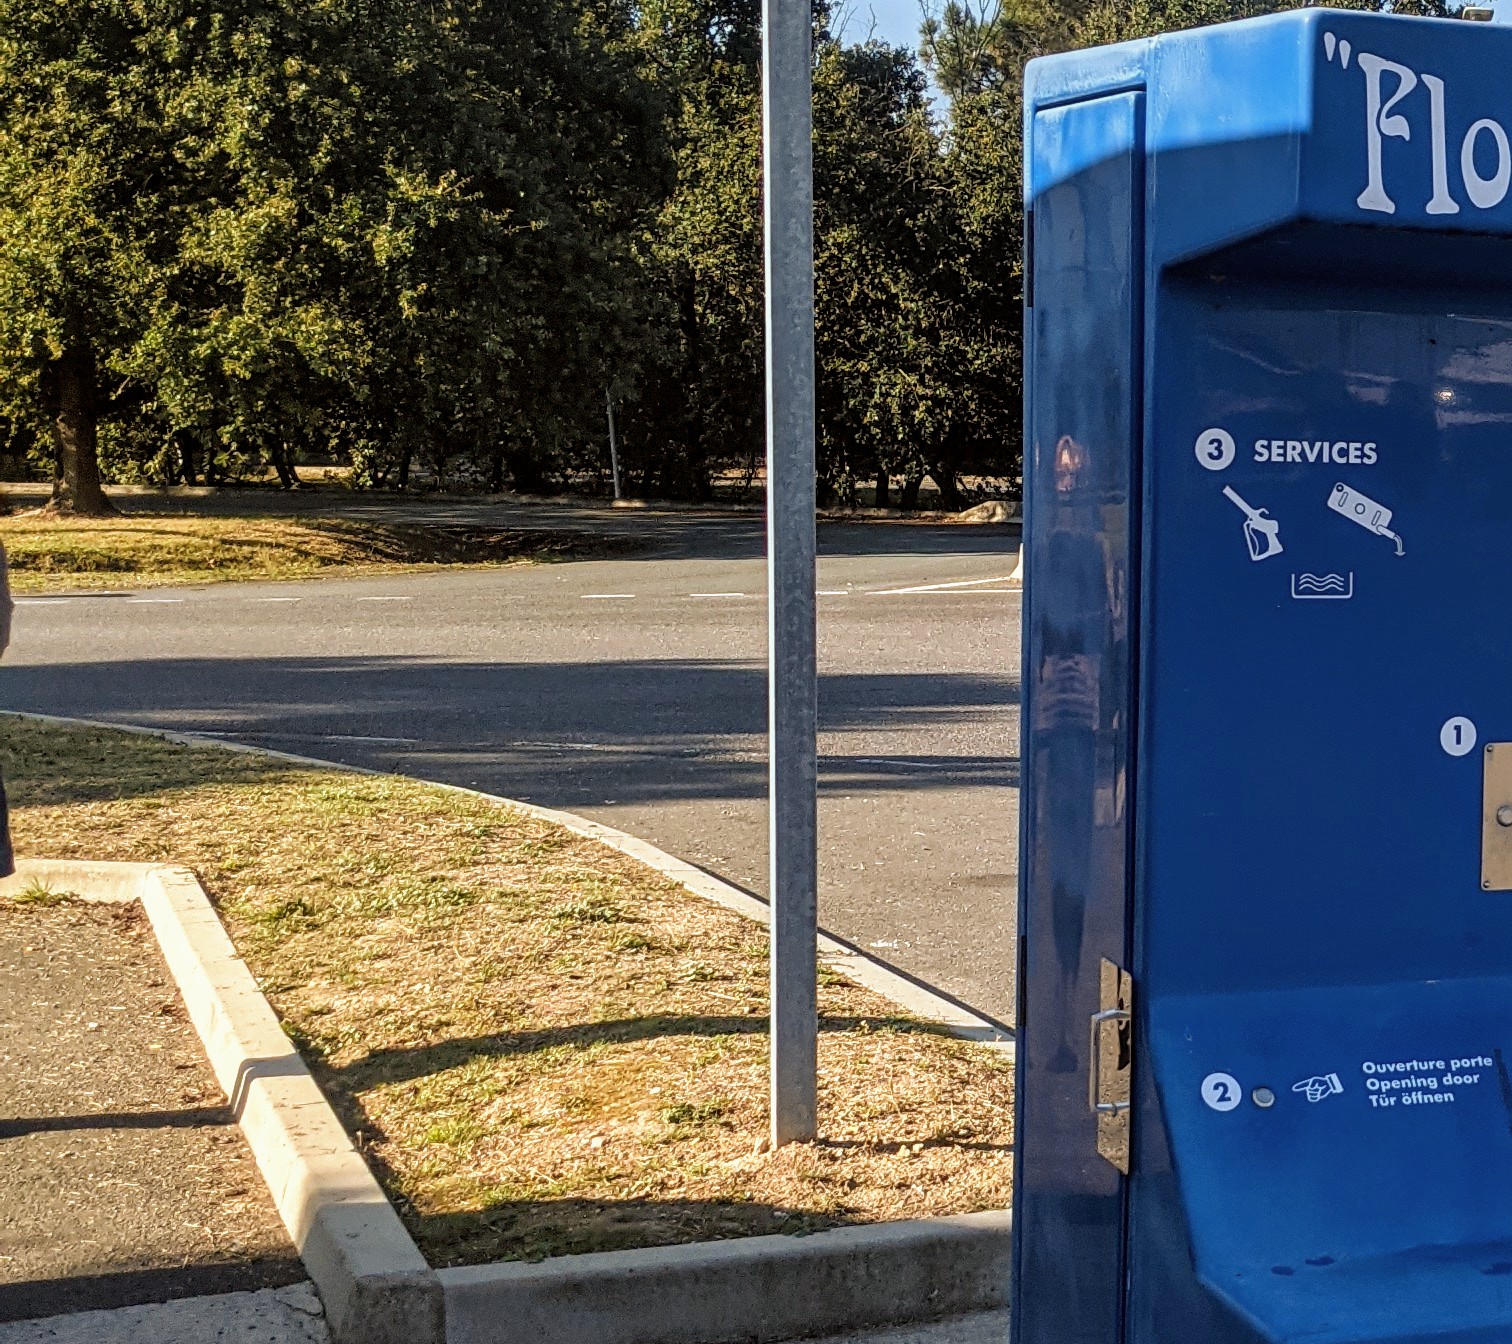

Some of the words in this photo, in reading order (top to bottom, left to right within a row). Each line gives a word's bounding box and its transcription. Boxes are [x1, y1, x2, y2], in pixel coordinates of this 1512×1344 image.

[1254, 440, 1377, 464] SERVICES
[1363, 1060, 1445, 1073] Ouverture
[1451, 1056, 1492, 1071] porte
[1366, 1075, 1438, 1093] Opening
[1443, 1072, 1480, 1085] door
[1369, 1094, 1397, 1107] Tür
[1402, 1091, 1454, 1105] öffnen
